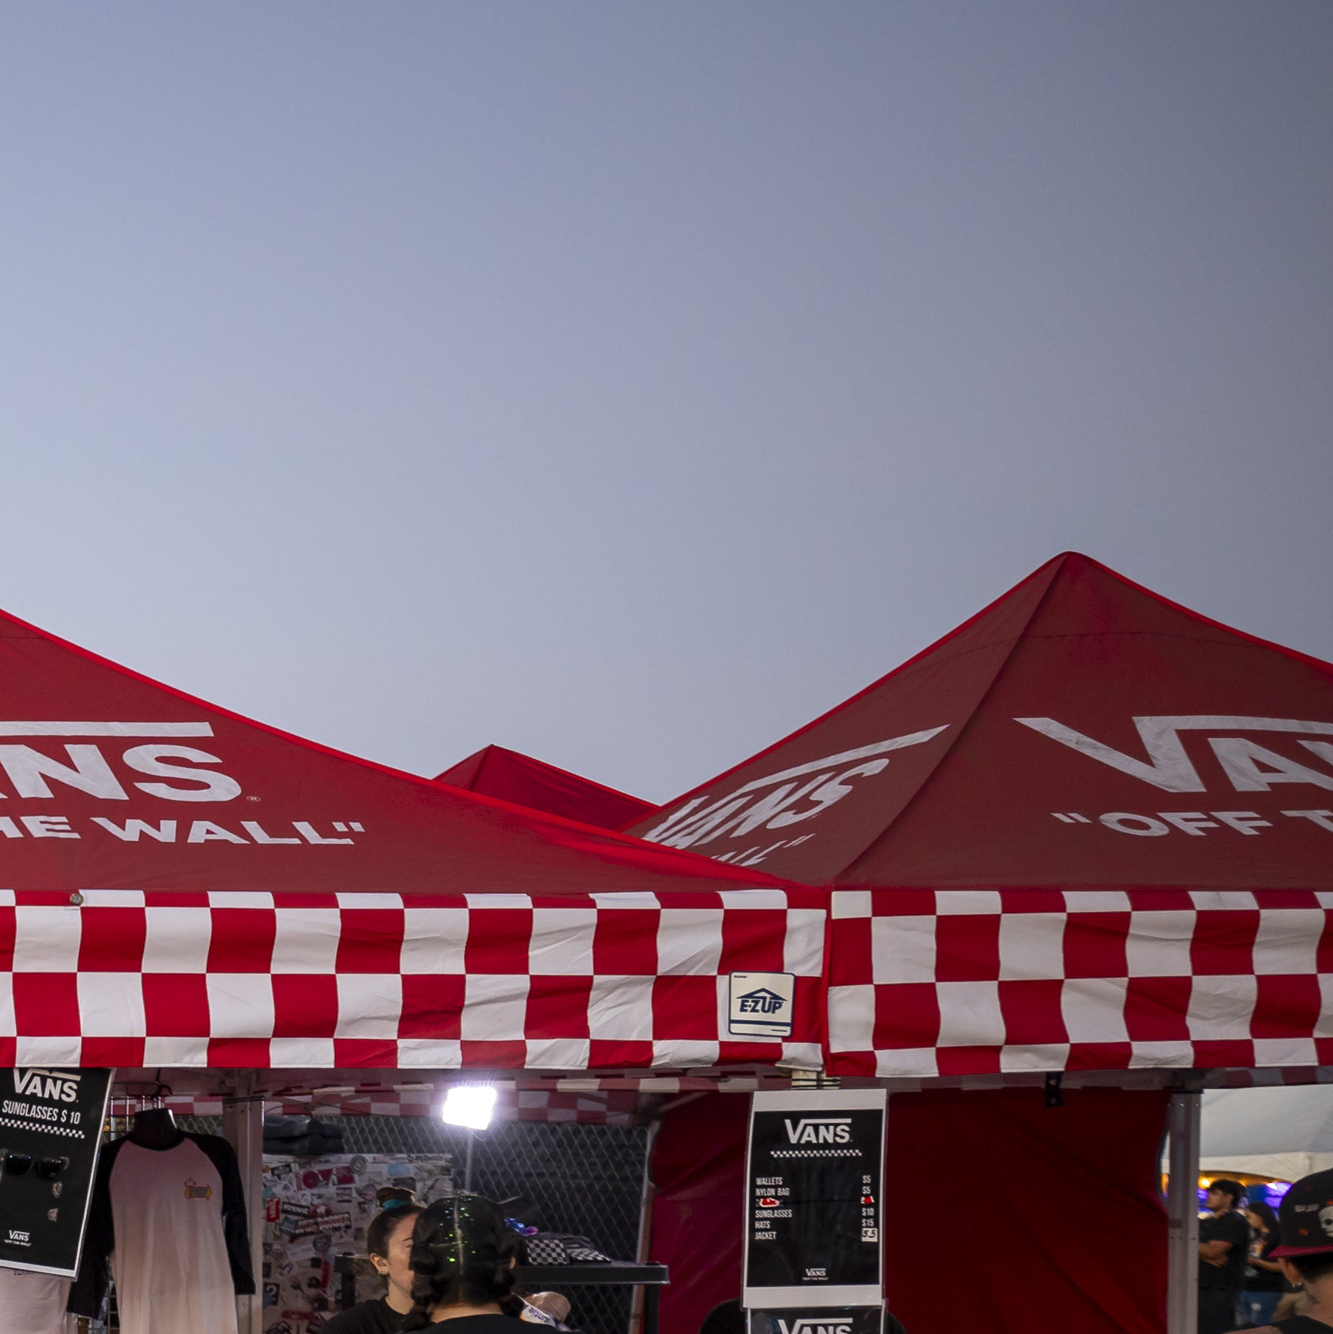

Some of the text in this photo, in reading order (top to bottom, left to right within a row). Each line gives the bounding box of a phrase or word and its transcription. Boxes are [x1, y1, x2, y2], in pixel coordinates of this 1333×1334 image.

[1013, 715, 1333, 792] VA
[1050, 811, 1274, 837] "OFF
[91, 816, 366, 847] WALL"
[13, 1068, 81, 1103] VANS
[2, 1100, 81, 1125] SUNGLASSES $ 10
[784, 1118, 852, 1144] VANS
[756, 1175, 871, 1185] WALLETS $5
[756, 1186, 871, 1196] NYLON BAG $5
[755, 1208, 874, 1218] SUNGLASSES $10
[755, 1219, 874, 1229] HATS $15
[9, 1229, 30, 1242] VANS
[754, 1232, 777, 1240] JACKET
[805, 1268, 826, 1277] VANS
